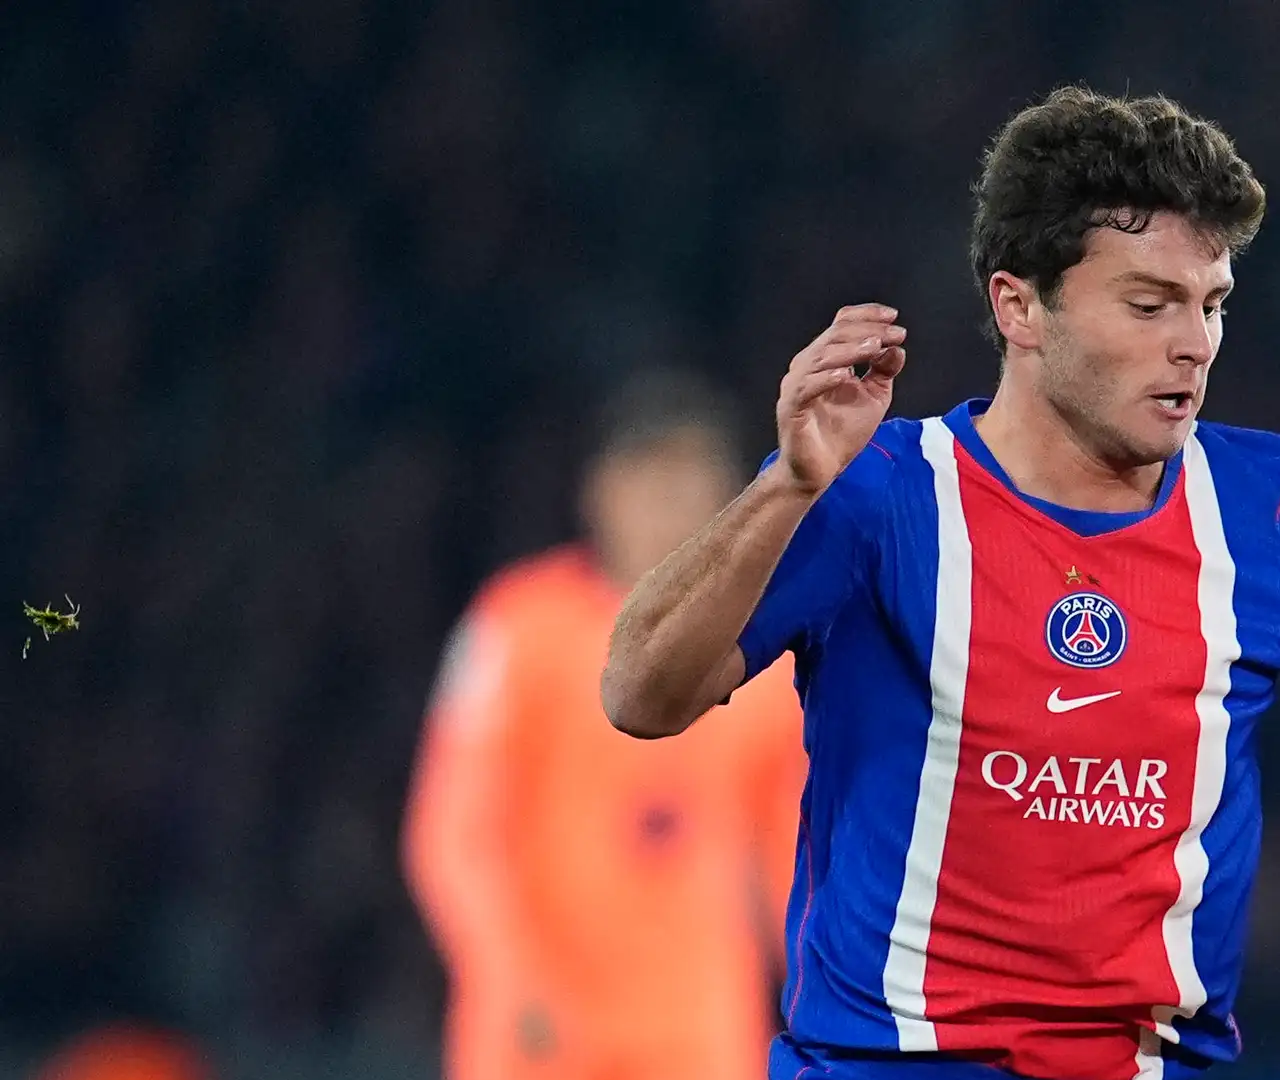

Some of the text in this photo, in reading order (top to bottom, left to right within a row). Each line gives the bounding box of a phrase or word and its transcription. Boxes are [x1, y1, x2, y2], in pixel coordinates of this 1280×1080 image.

[1060, 597, 1112, 619] PARIS
[981, 750, 1169, 802] QATAR
[1023, 796, 1166, 829] AIRWAYS
